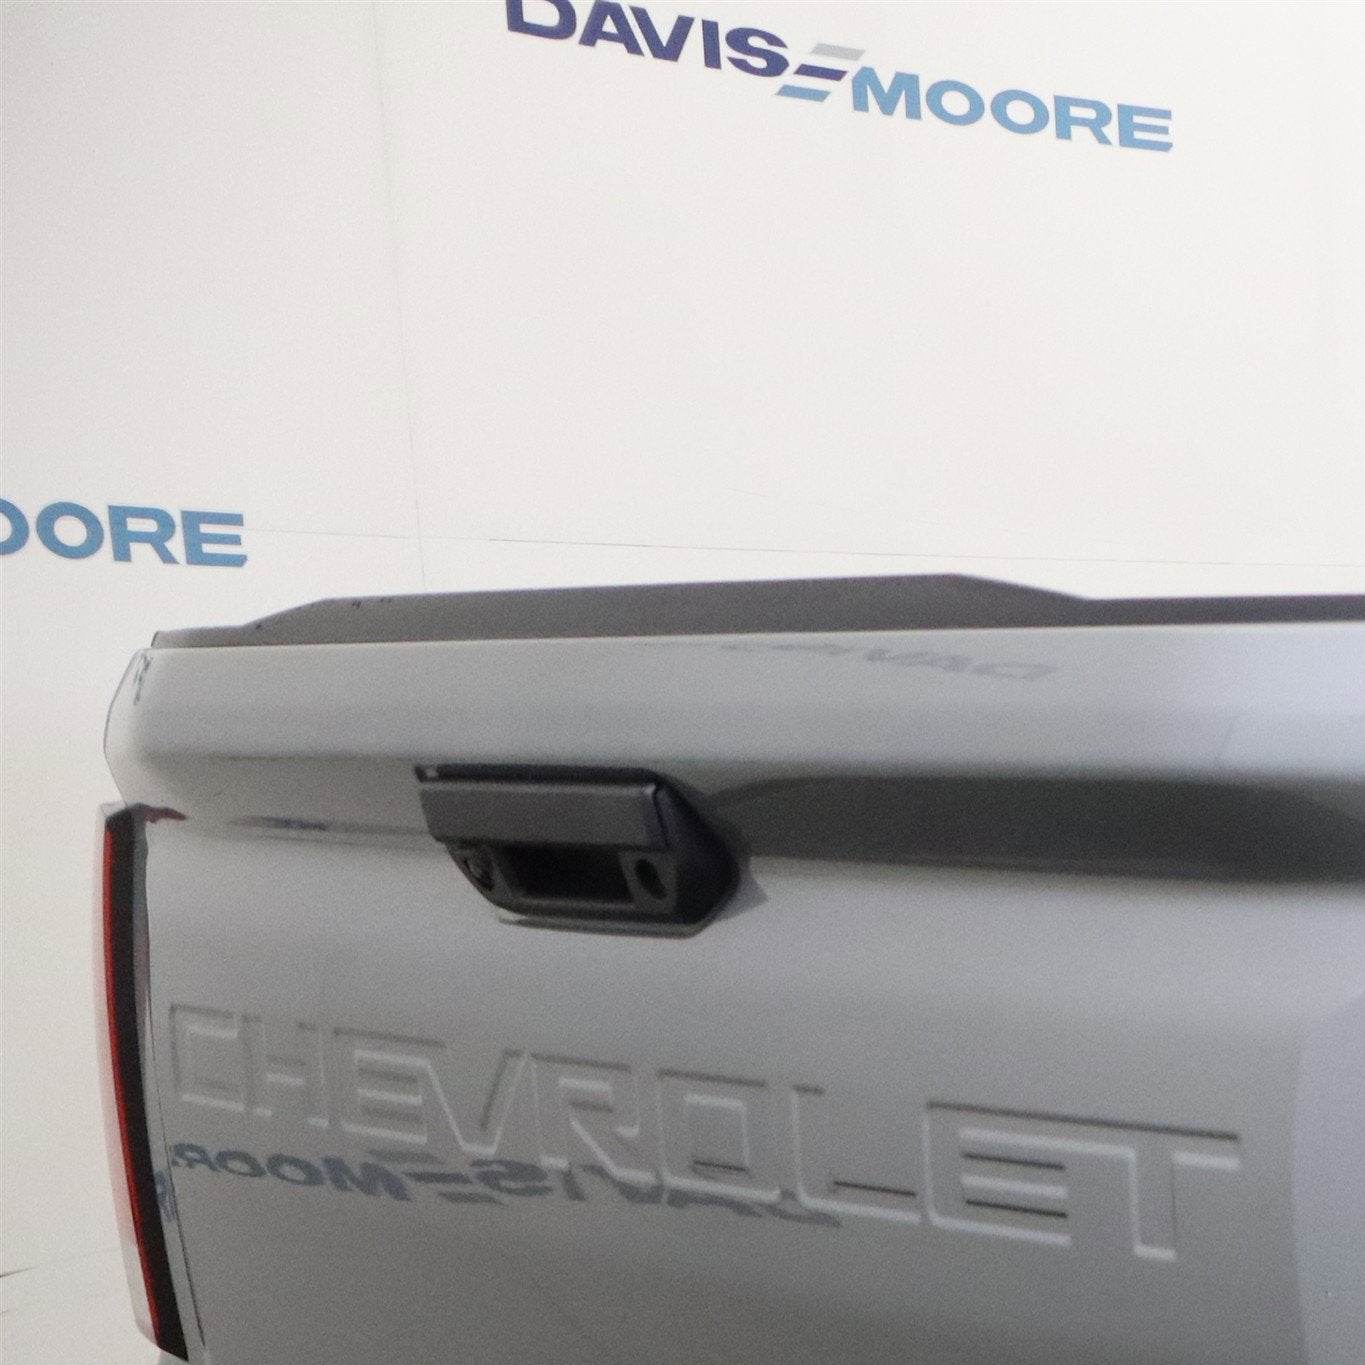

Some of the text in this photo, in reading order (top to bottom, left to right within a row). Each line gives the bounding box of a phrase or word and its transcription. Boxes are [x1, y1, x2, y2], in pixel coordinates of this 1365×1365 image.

[507, 0, 1173, 152] DAVIS MOORE
[170, 1005, 1240, 1261] CHEVROLET
